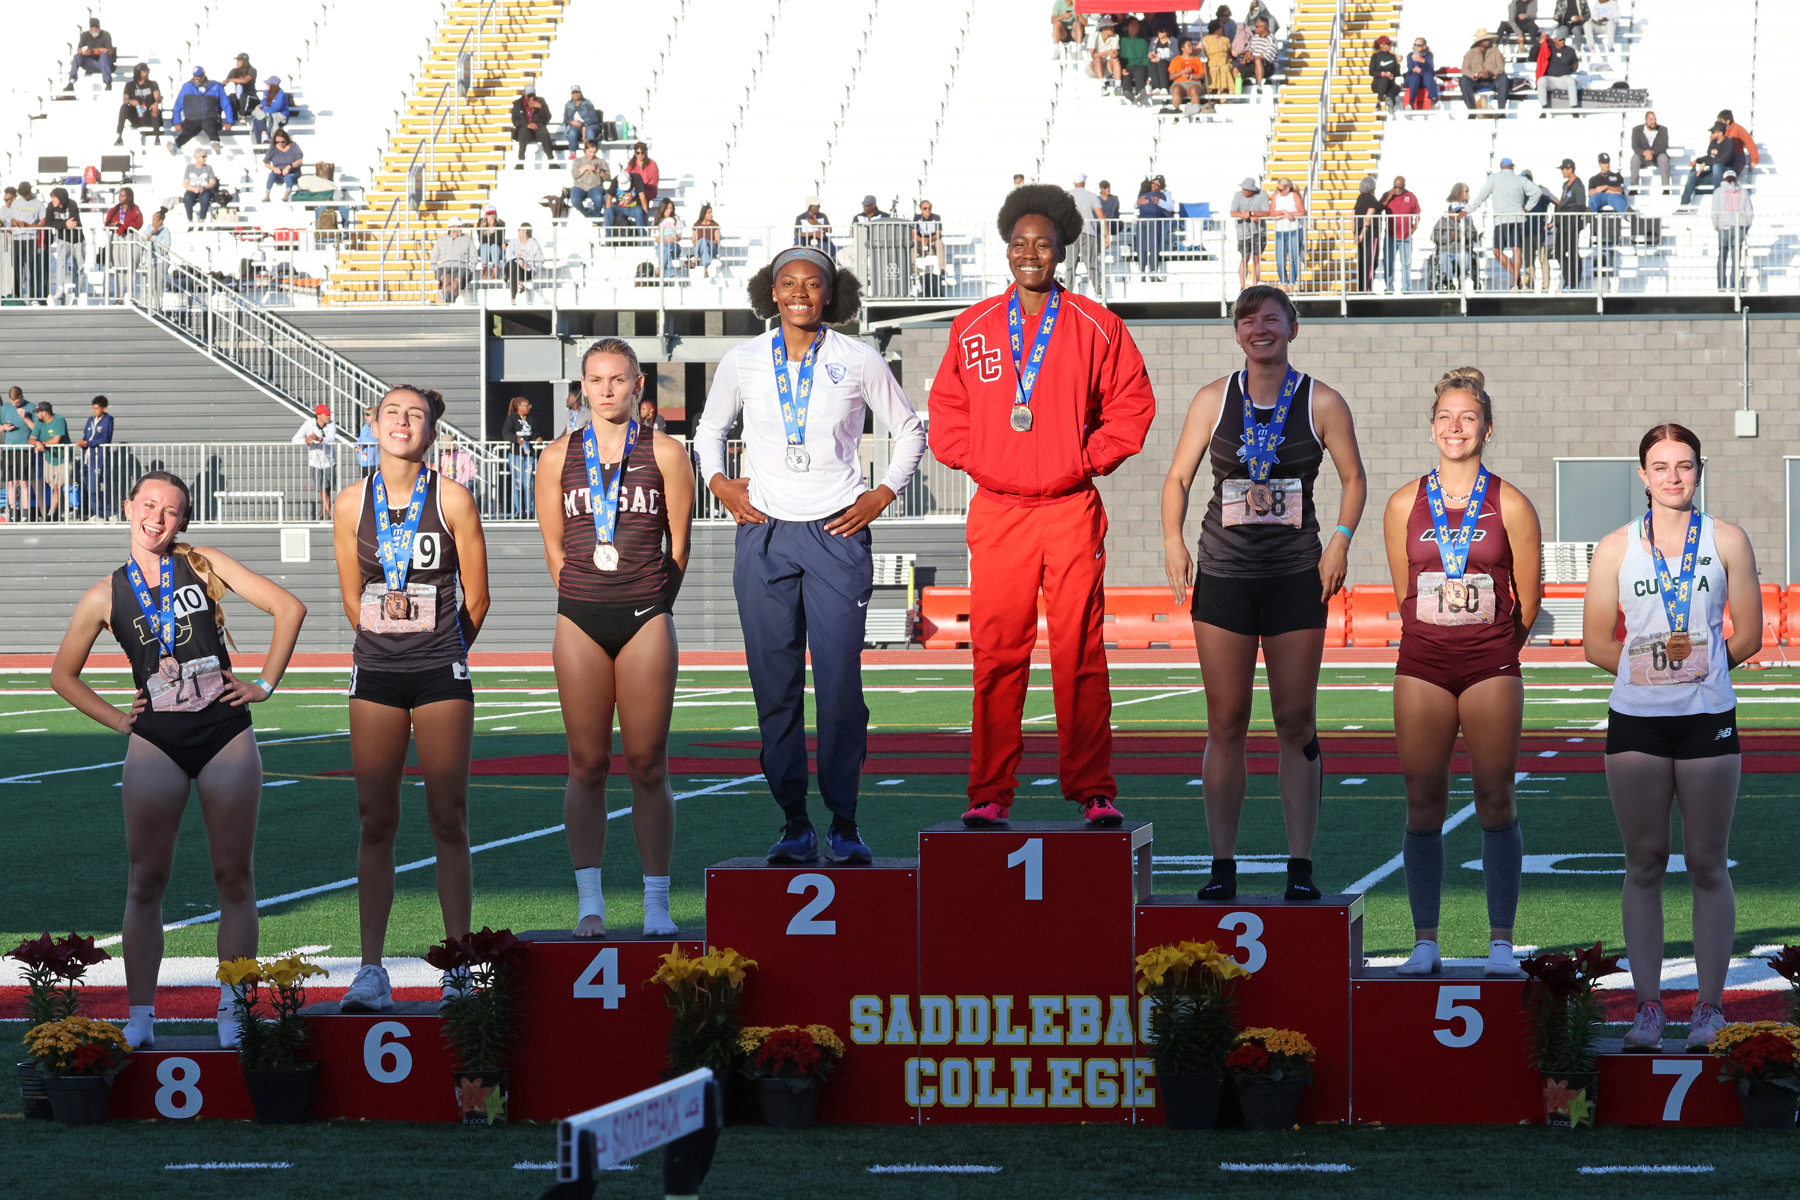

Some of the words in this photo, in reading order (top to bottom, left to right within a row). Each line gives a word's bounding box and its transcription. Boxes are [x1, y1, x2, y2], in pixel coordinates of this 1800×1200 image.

[962, 334, 1002, 383] BC
[619, 486, 661, 514] SAC
[1241, 490, 1286, 516] 18
[420, 535, 435, 568] 9
[174, 588, 202, 612] 10
[377, 594, 419, 621] 15
[1434, 584, 1479, 613] 10
[1007, 838, 1043, 900] 1
[786, 873, 836, 935] 2
[1217, 911, 1267, 974] 3
[573, 948, 626, 1009] 4
[1433, 986, 1484, 1048] 5
[363, 1021, 413, 1083] 6
[155, 1057, 203, 1119] 8
[904, 1057, 1156, 1108] COLLEGE
[1652, 1059, 1702, 1121] 7
